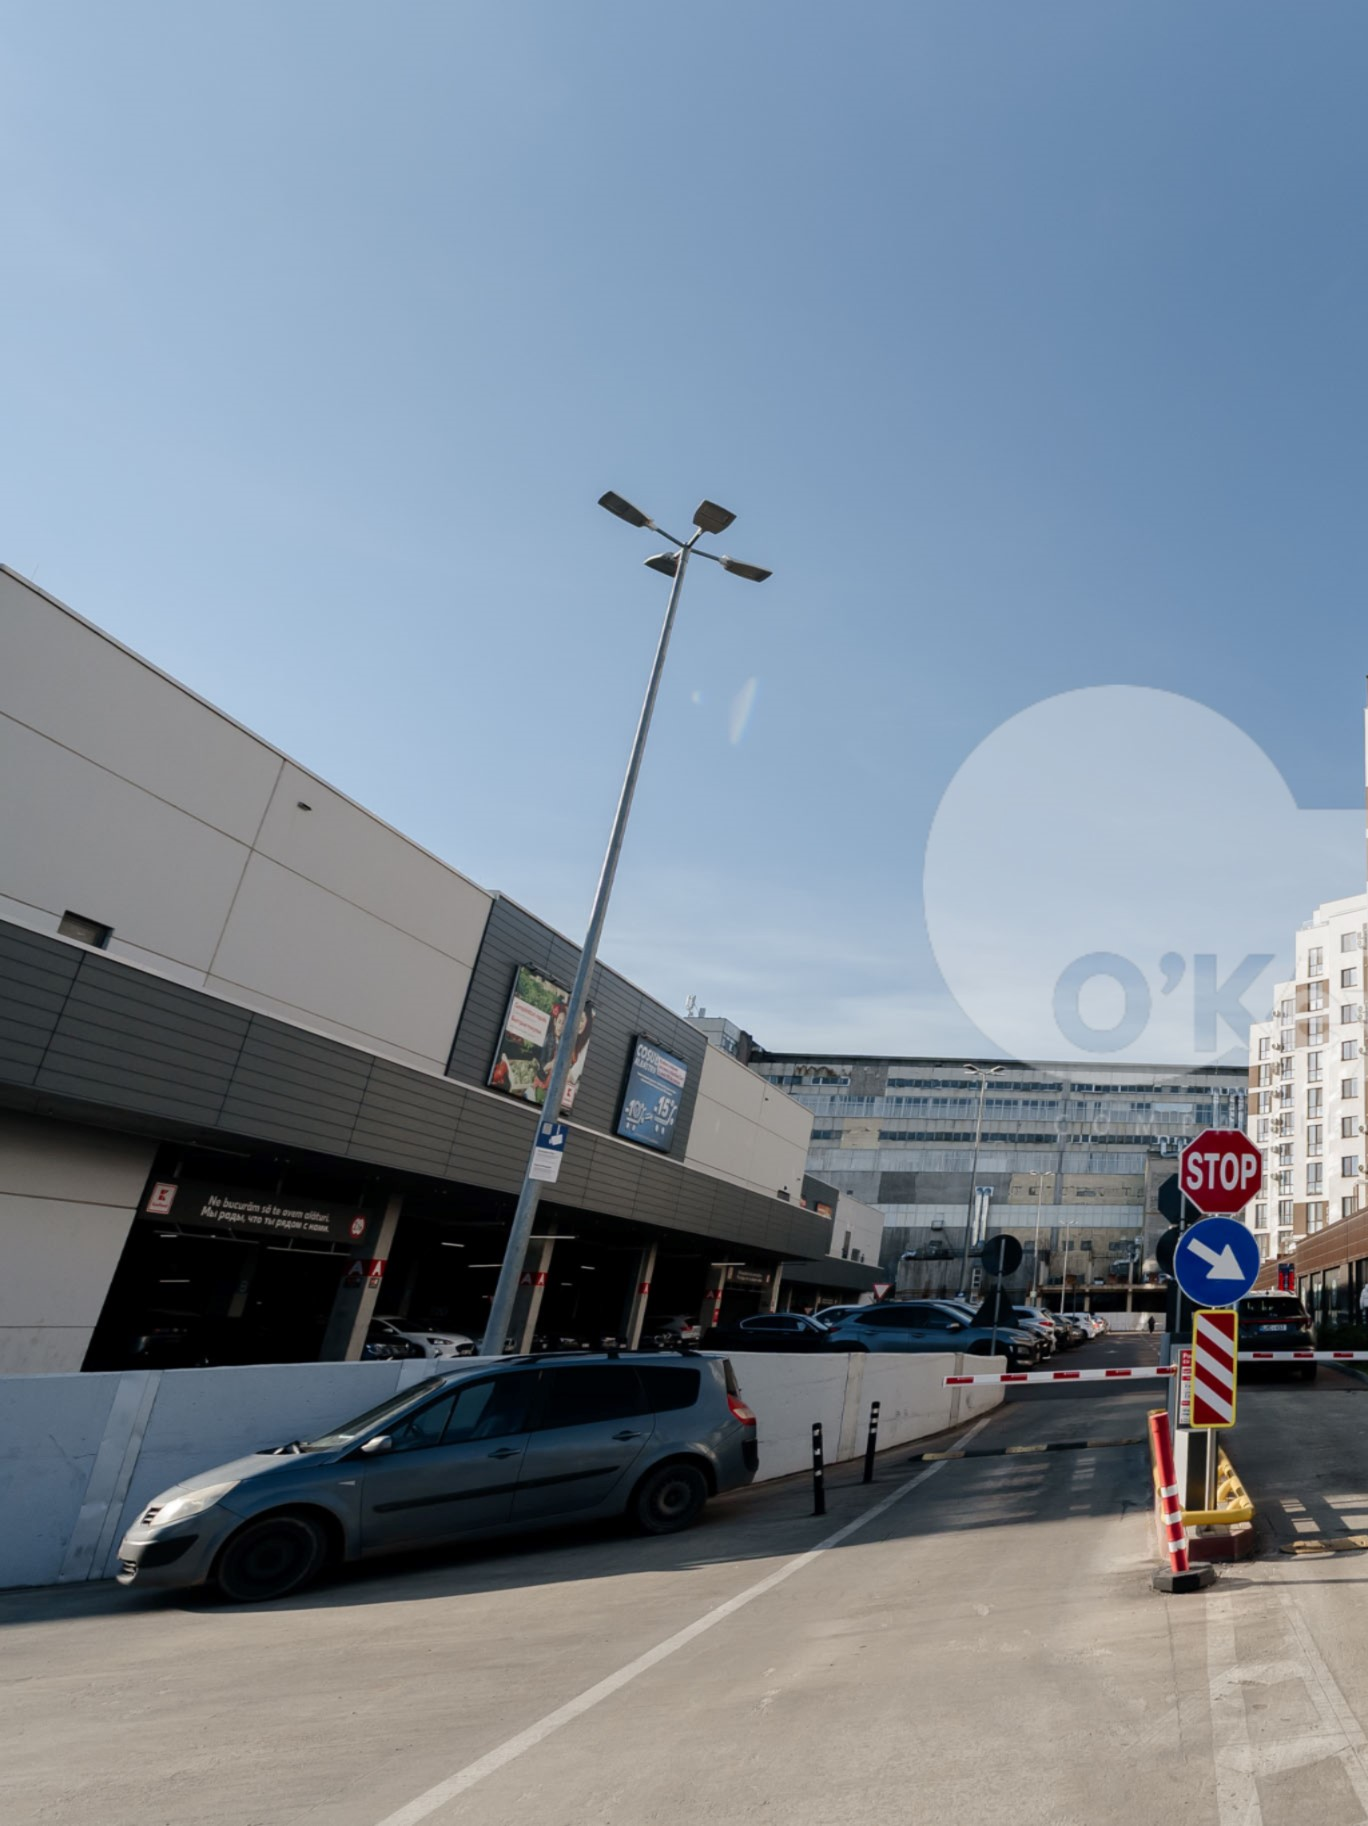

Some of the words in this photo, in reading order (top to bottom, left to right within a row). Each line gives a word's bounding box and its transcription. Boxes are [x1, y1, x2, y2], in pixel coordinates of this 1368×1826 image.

[1186, 1152, 1257, 1191] STOP
[201, 1206, 217, 1218] Мы
[218, 1210, 245, 1223] рады,
[248, 1215, 262, 1224] что
[264, 1217, 275, 1225] ты
[275, 1219, 302, 1229] рядом
[208, 1195, 221, 1206] Ne
[223, 1197, 260, 1212] bucurăm
[262, 1204, 271, 1214] să
[272, 1206, 281, 1215] te
[282, 1209, 303, 1219] avem
